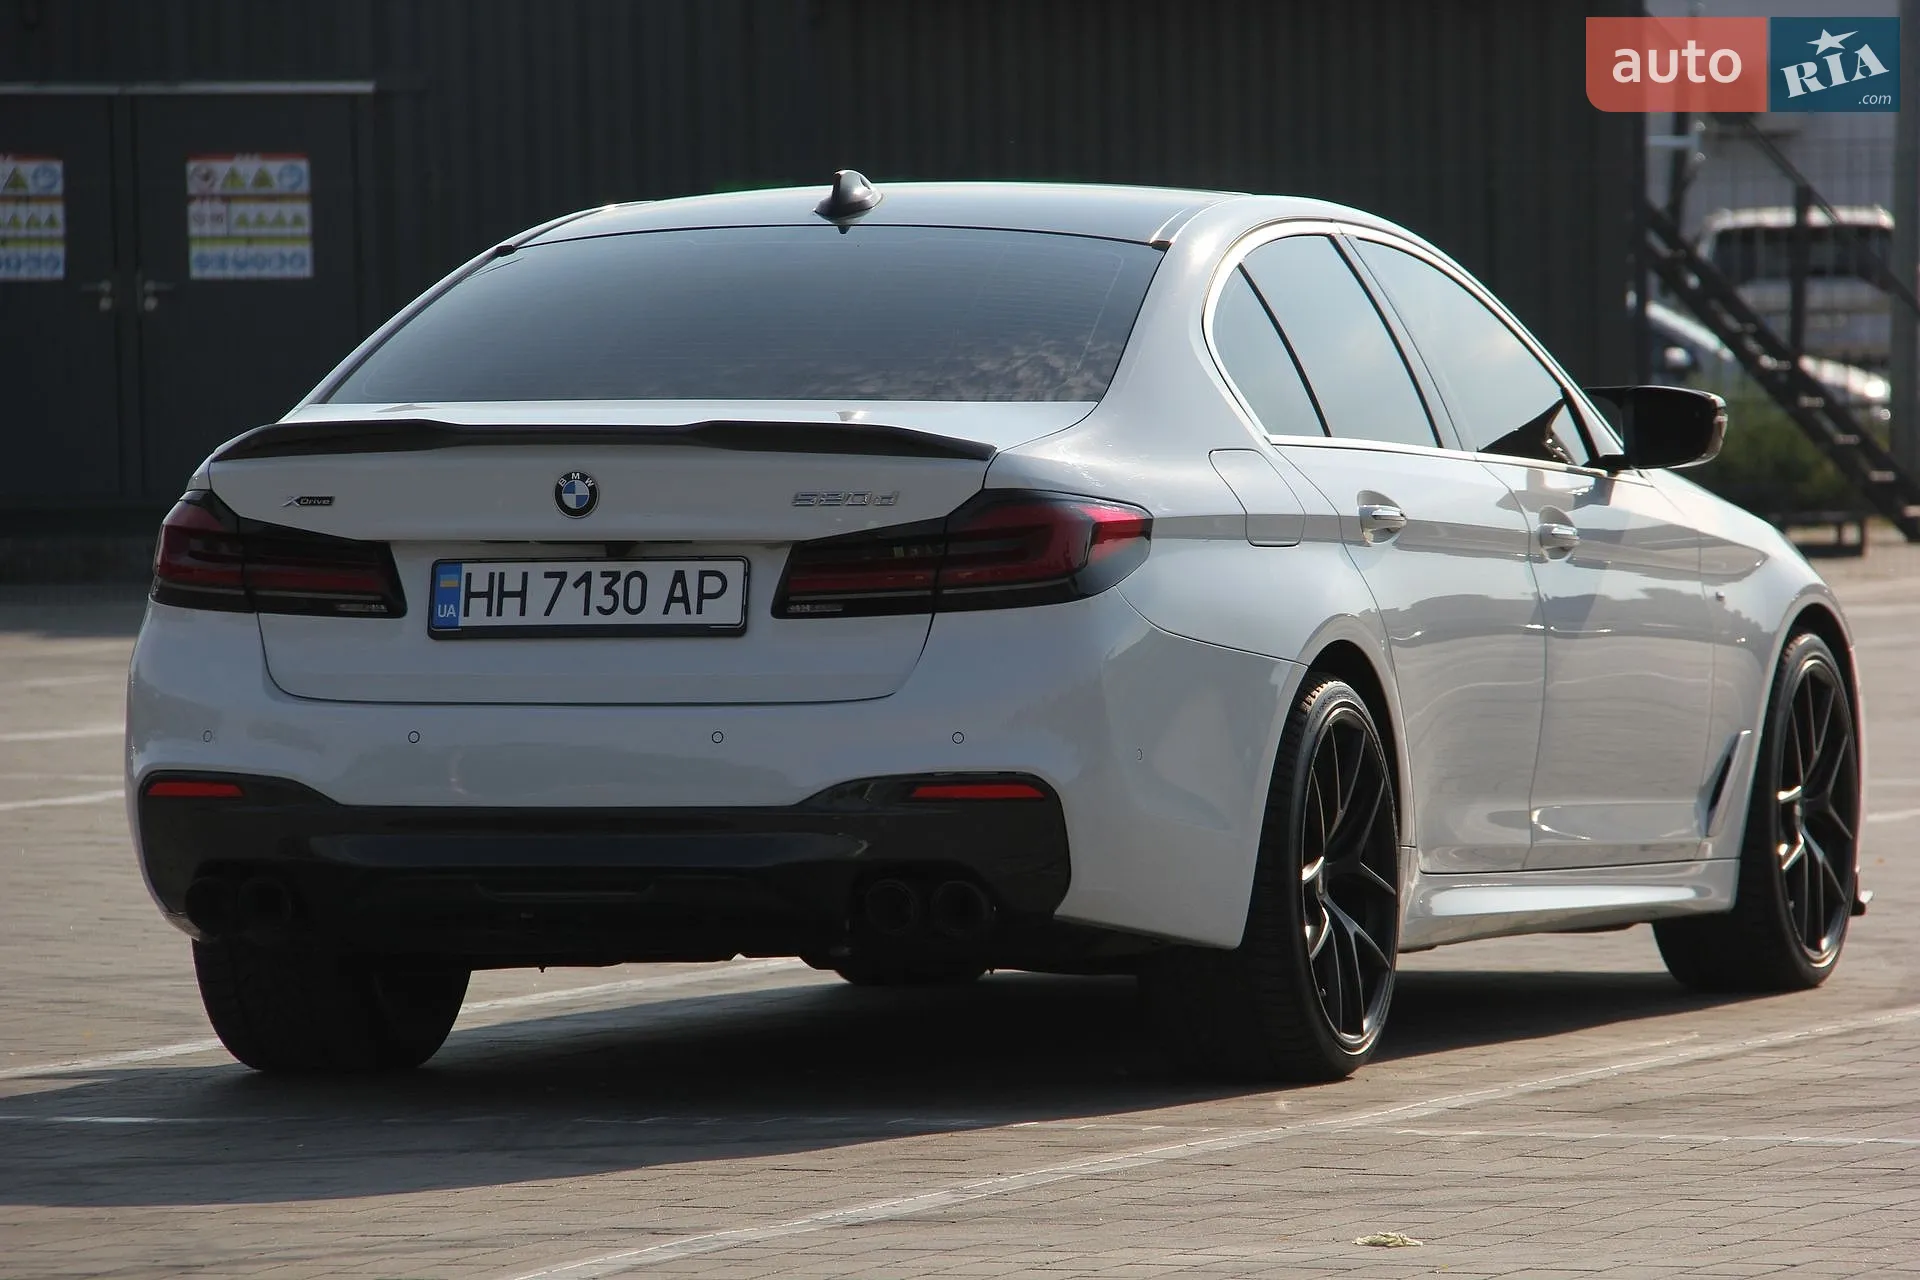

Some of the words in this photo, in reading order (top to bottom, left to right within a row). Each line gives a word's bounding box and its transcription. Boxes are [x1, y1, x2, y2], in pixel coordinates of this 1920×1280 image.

[558, 472, 595, 487] BMW
[463, 571, 528, 617] HH
[543, 570, 648, 617] 7130
[662, 569, 728, 615] AP
[437, 604, 456, 617] UA
